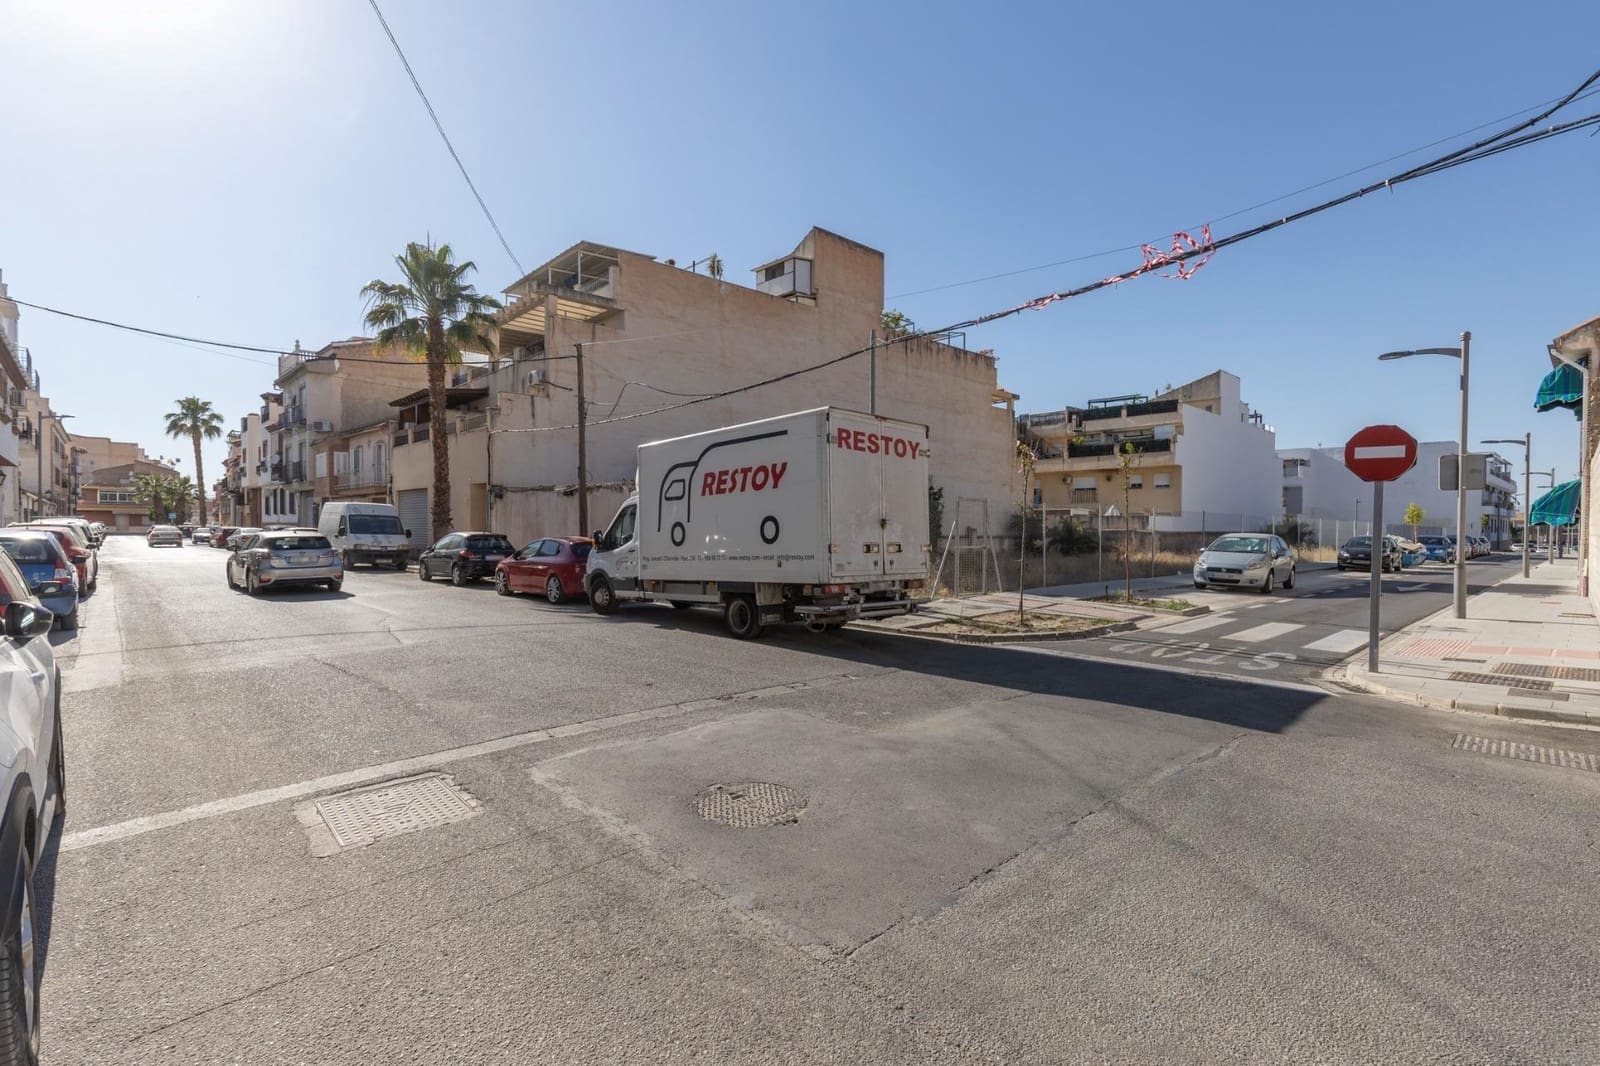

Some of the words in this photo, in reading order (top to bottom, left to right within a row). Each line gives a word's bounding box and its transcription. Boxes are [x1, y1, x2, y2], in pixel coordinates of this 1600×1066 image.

[837, 427, 920, 460] RESTOY
[701, 462, 788, 497] RESTOY
[1109, 639, 1297, 670] STOP
